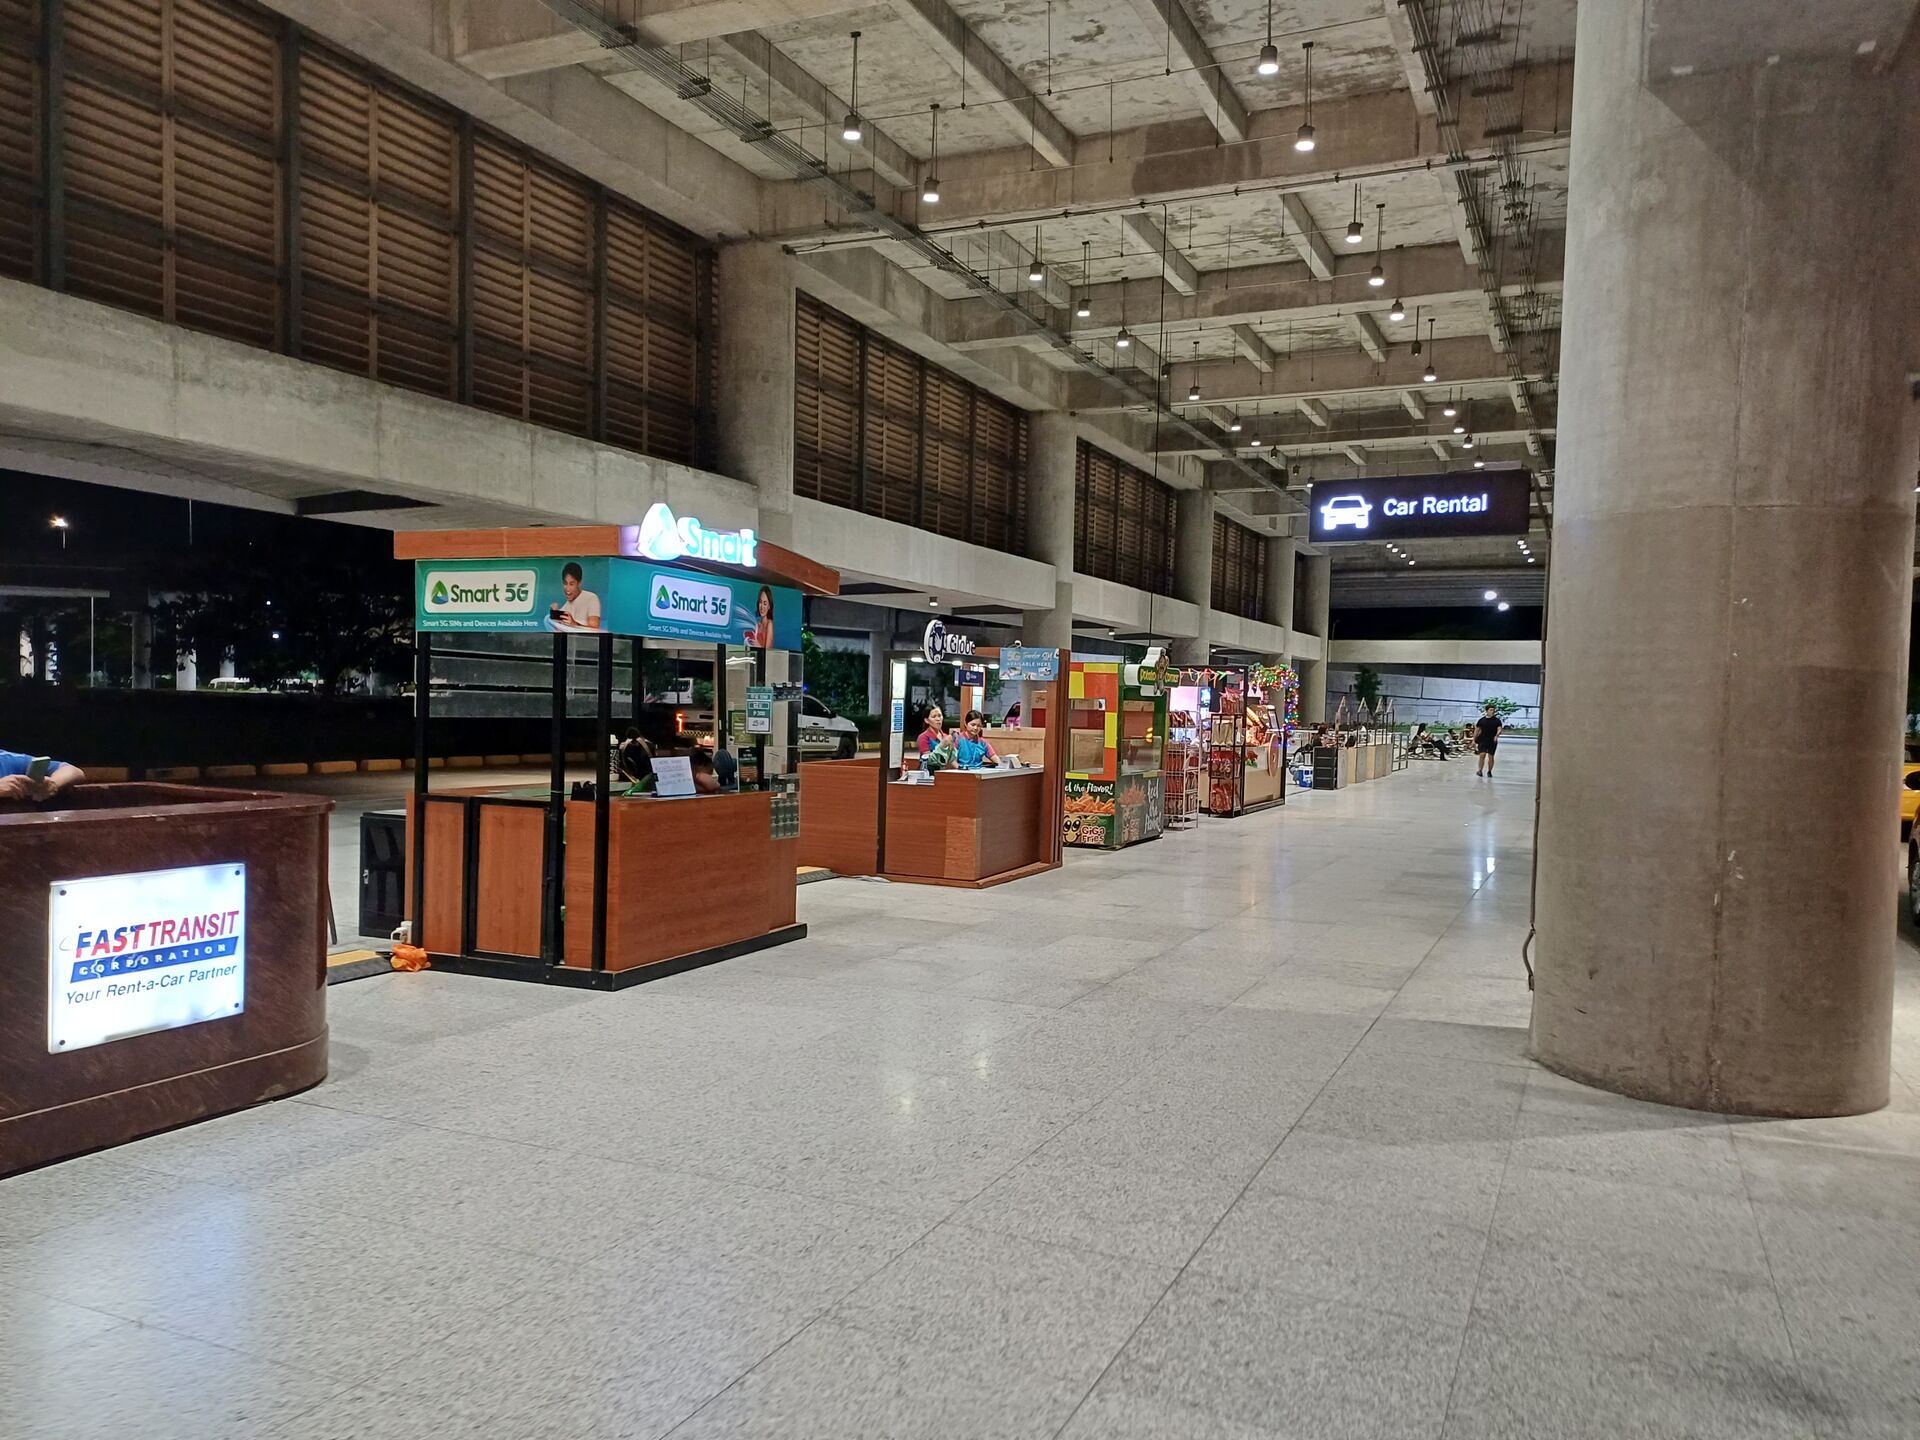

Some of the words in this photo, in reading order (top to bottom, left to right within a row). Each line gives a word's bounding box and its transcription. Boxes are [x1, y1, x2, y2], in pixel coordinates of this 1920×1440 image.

[1383, 498, 1417, 516] Car
[1423, 493, 1488, 515] Rental
[677, 516, 757, 567] Smart
[450, 583, 500, 603] Smart
[504, 583, 529, 602] 5G
[671, 591, 708, 614] Smart
[711, 596, 728, 616] 5G
[947, 633, 977, 656] Globe
[798, 732, 831, 743] POLICE
[1073, 783, 1086, 793] the
[78, 943, 227, 976] CORPORATION
[66, 987, 102, 1005] Your
[106, 973, 186, 998] Rent-a-Car
[188, 964, 237, 983] Partner
